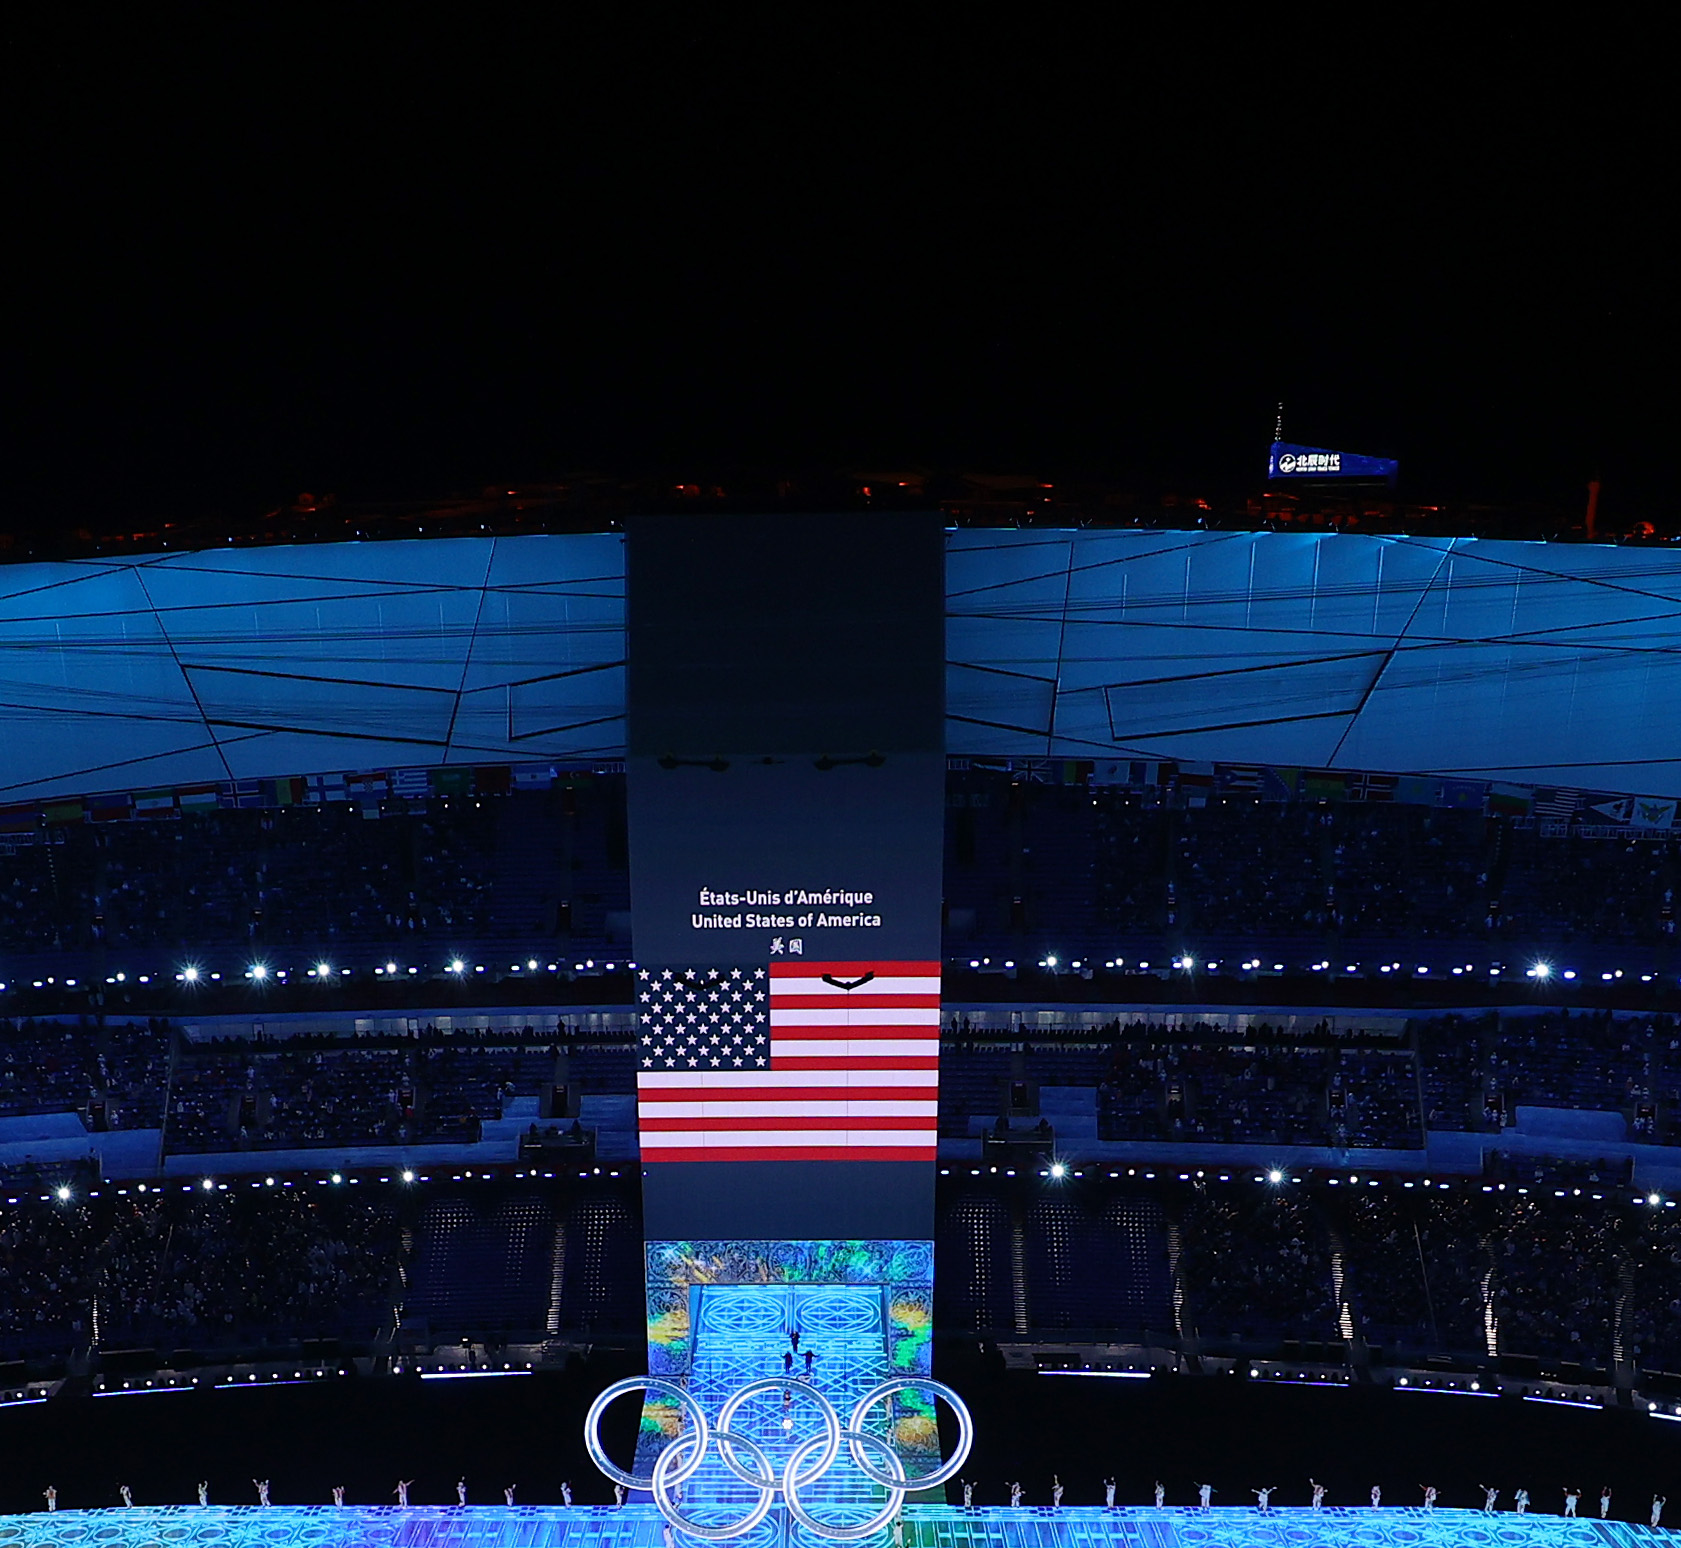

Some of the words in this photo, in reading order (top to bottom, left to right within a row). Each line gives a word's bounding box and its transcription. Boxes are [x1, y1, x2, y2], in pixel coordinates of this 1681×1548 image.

[699, 886, 781, 906] États-Unis
[691, 913, 742, 929] United
[745, 913, 795, 928] States
[797, 912, 814, 928] of
[816, 912, 881, 928] America
